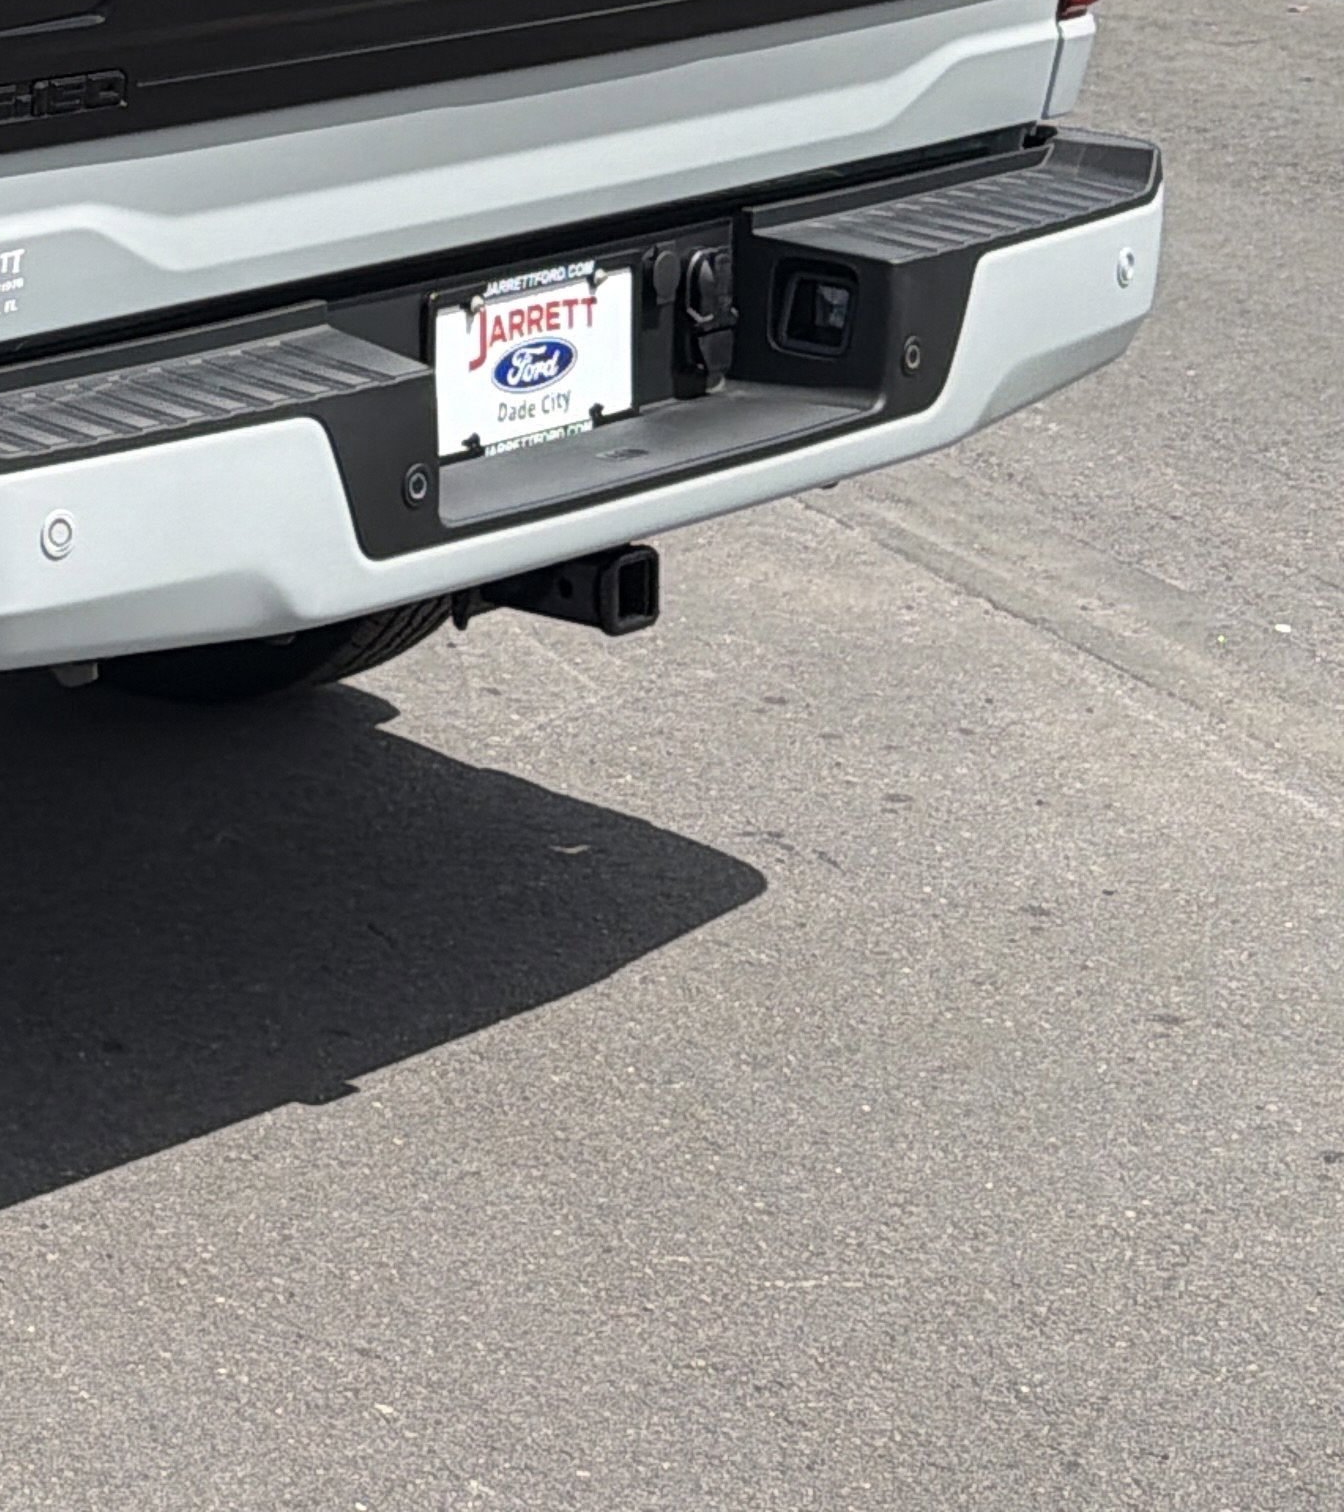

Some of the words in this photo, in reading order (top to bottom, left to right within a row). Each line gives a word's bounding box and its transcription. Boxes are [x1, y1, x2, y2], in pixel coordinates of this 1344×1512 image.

[469, 296, 598, 372] JARRETT
[507, 345, 560, 386] Ford
[497, 397, 536, 422] Dade
[541, 389, 572, 413] City
